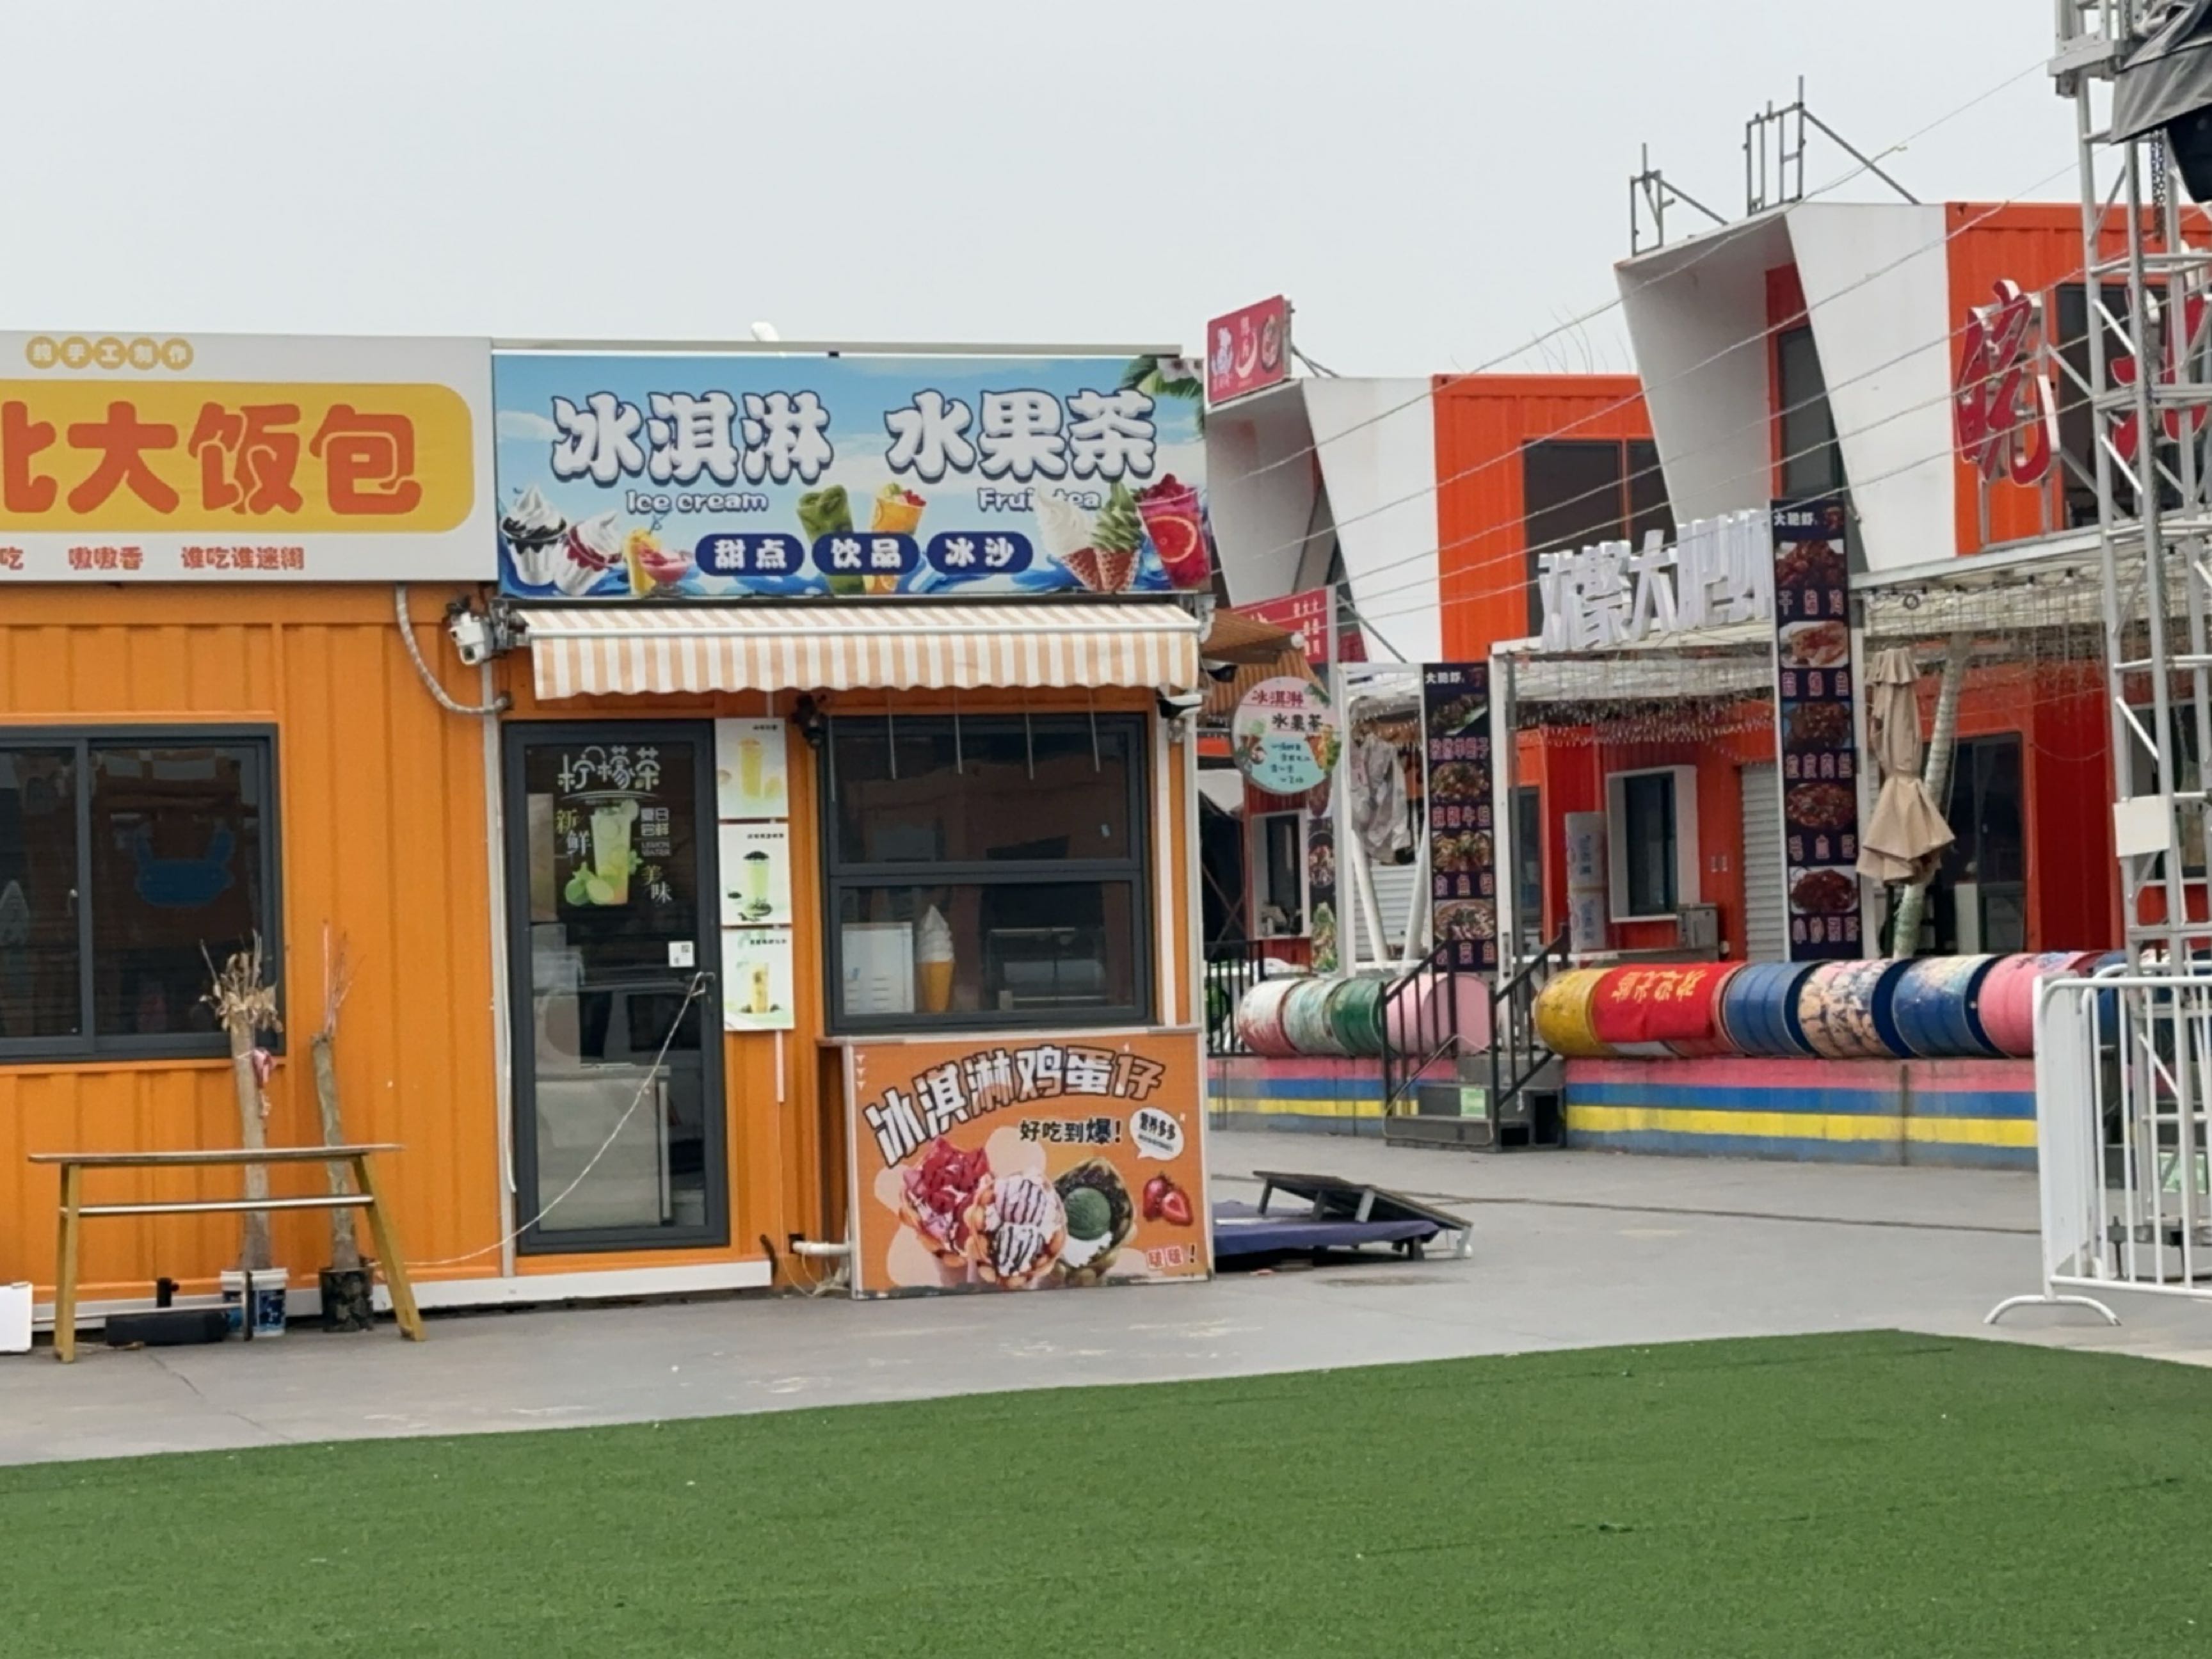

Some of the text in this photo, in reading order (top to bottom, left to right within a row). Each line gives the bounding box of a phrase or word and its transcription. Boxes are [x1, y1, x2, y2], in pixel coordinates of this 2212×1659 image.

[551, 388, 1157, 488] 冰淇淋 水果茶
[627, 490, 669, 513] Ice
[677, 491, 769, 513] cream
[977, 487, 1036, 512] Frui
[714, 537, 1014, 570] 甜点 饮品 冰沙
[1251, 689, 1304, 707] 冰淇淋
[1272, 712, 1322, 732] 水果茶
[557, 746, 661, 793] 柠檬茶
[863, 1045, 1166, 1168] 冰淇淋鸡蛋仔
